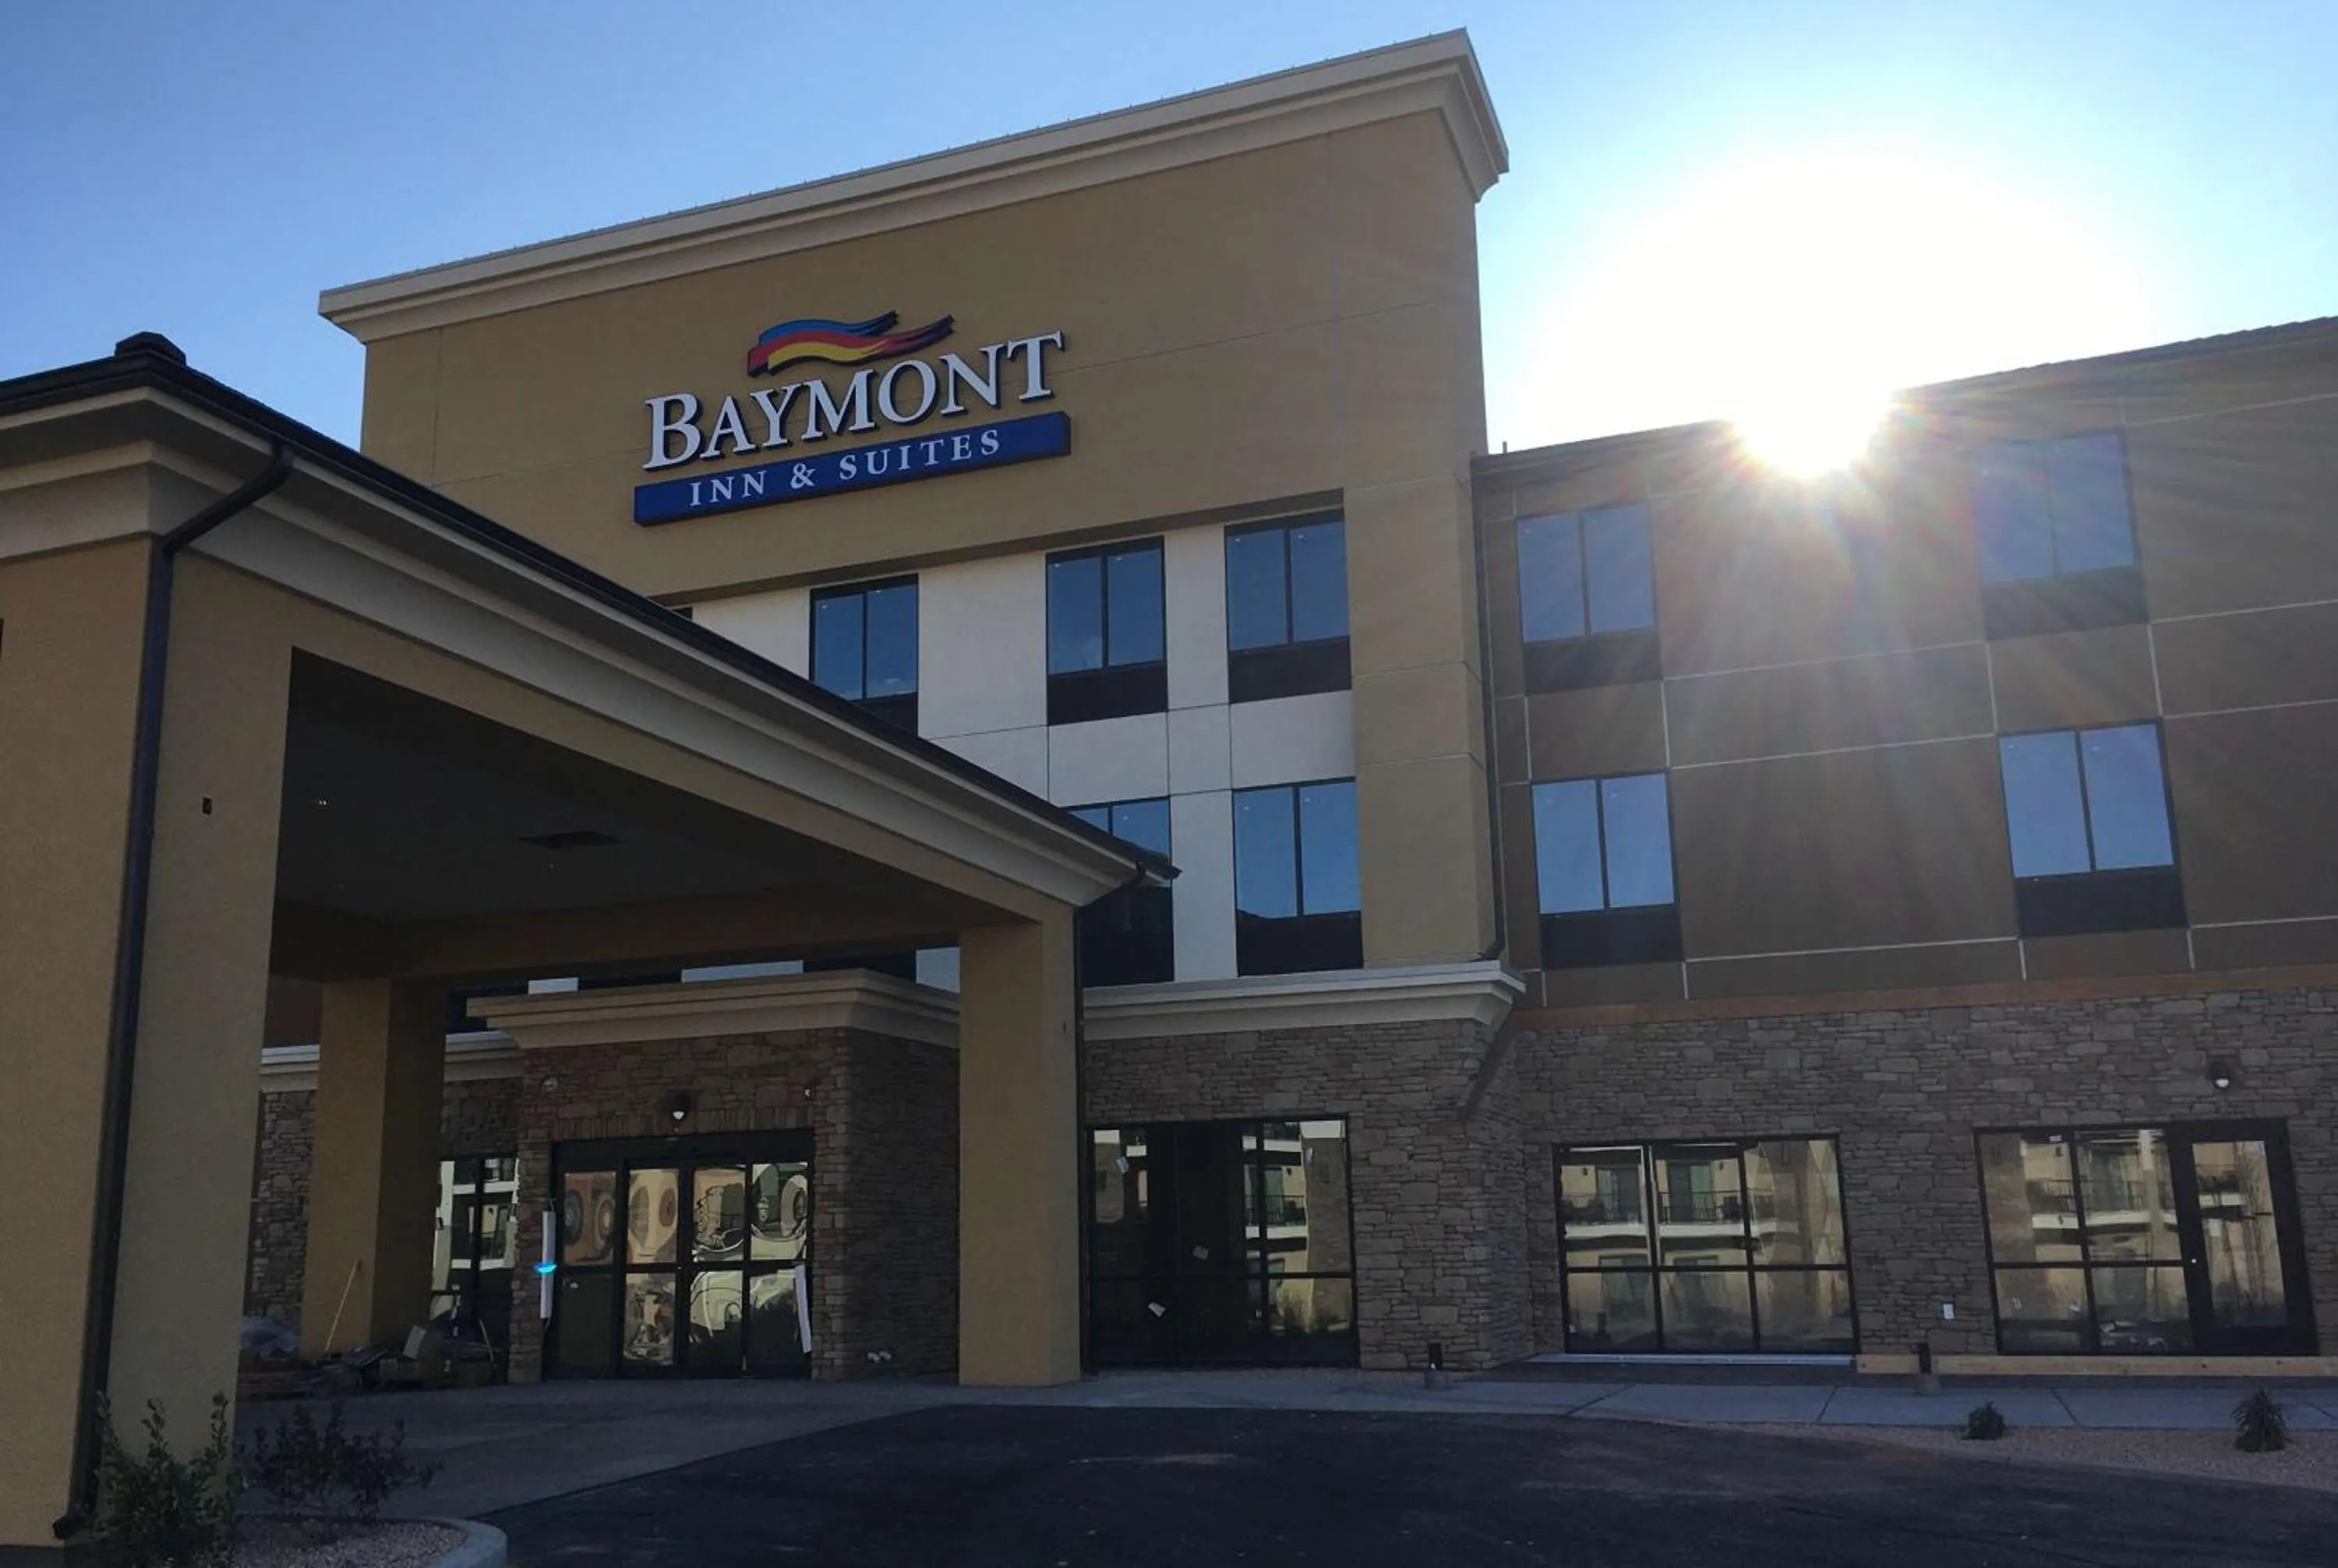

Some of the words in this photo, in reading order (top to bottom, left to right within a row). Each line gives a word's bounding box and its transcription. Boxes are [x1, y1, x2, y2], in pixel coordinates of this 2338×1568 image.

[643, 330, 1065, 470] BAYMONT
[690, 471, 766, 507] INN
[789, 464, 816, 490] &
[839, 429, 1001, 482] SUITES
